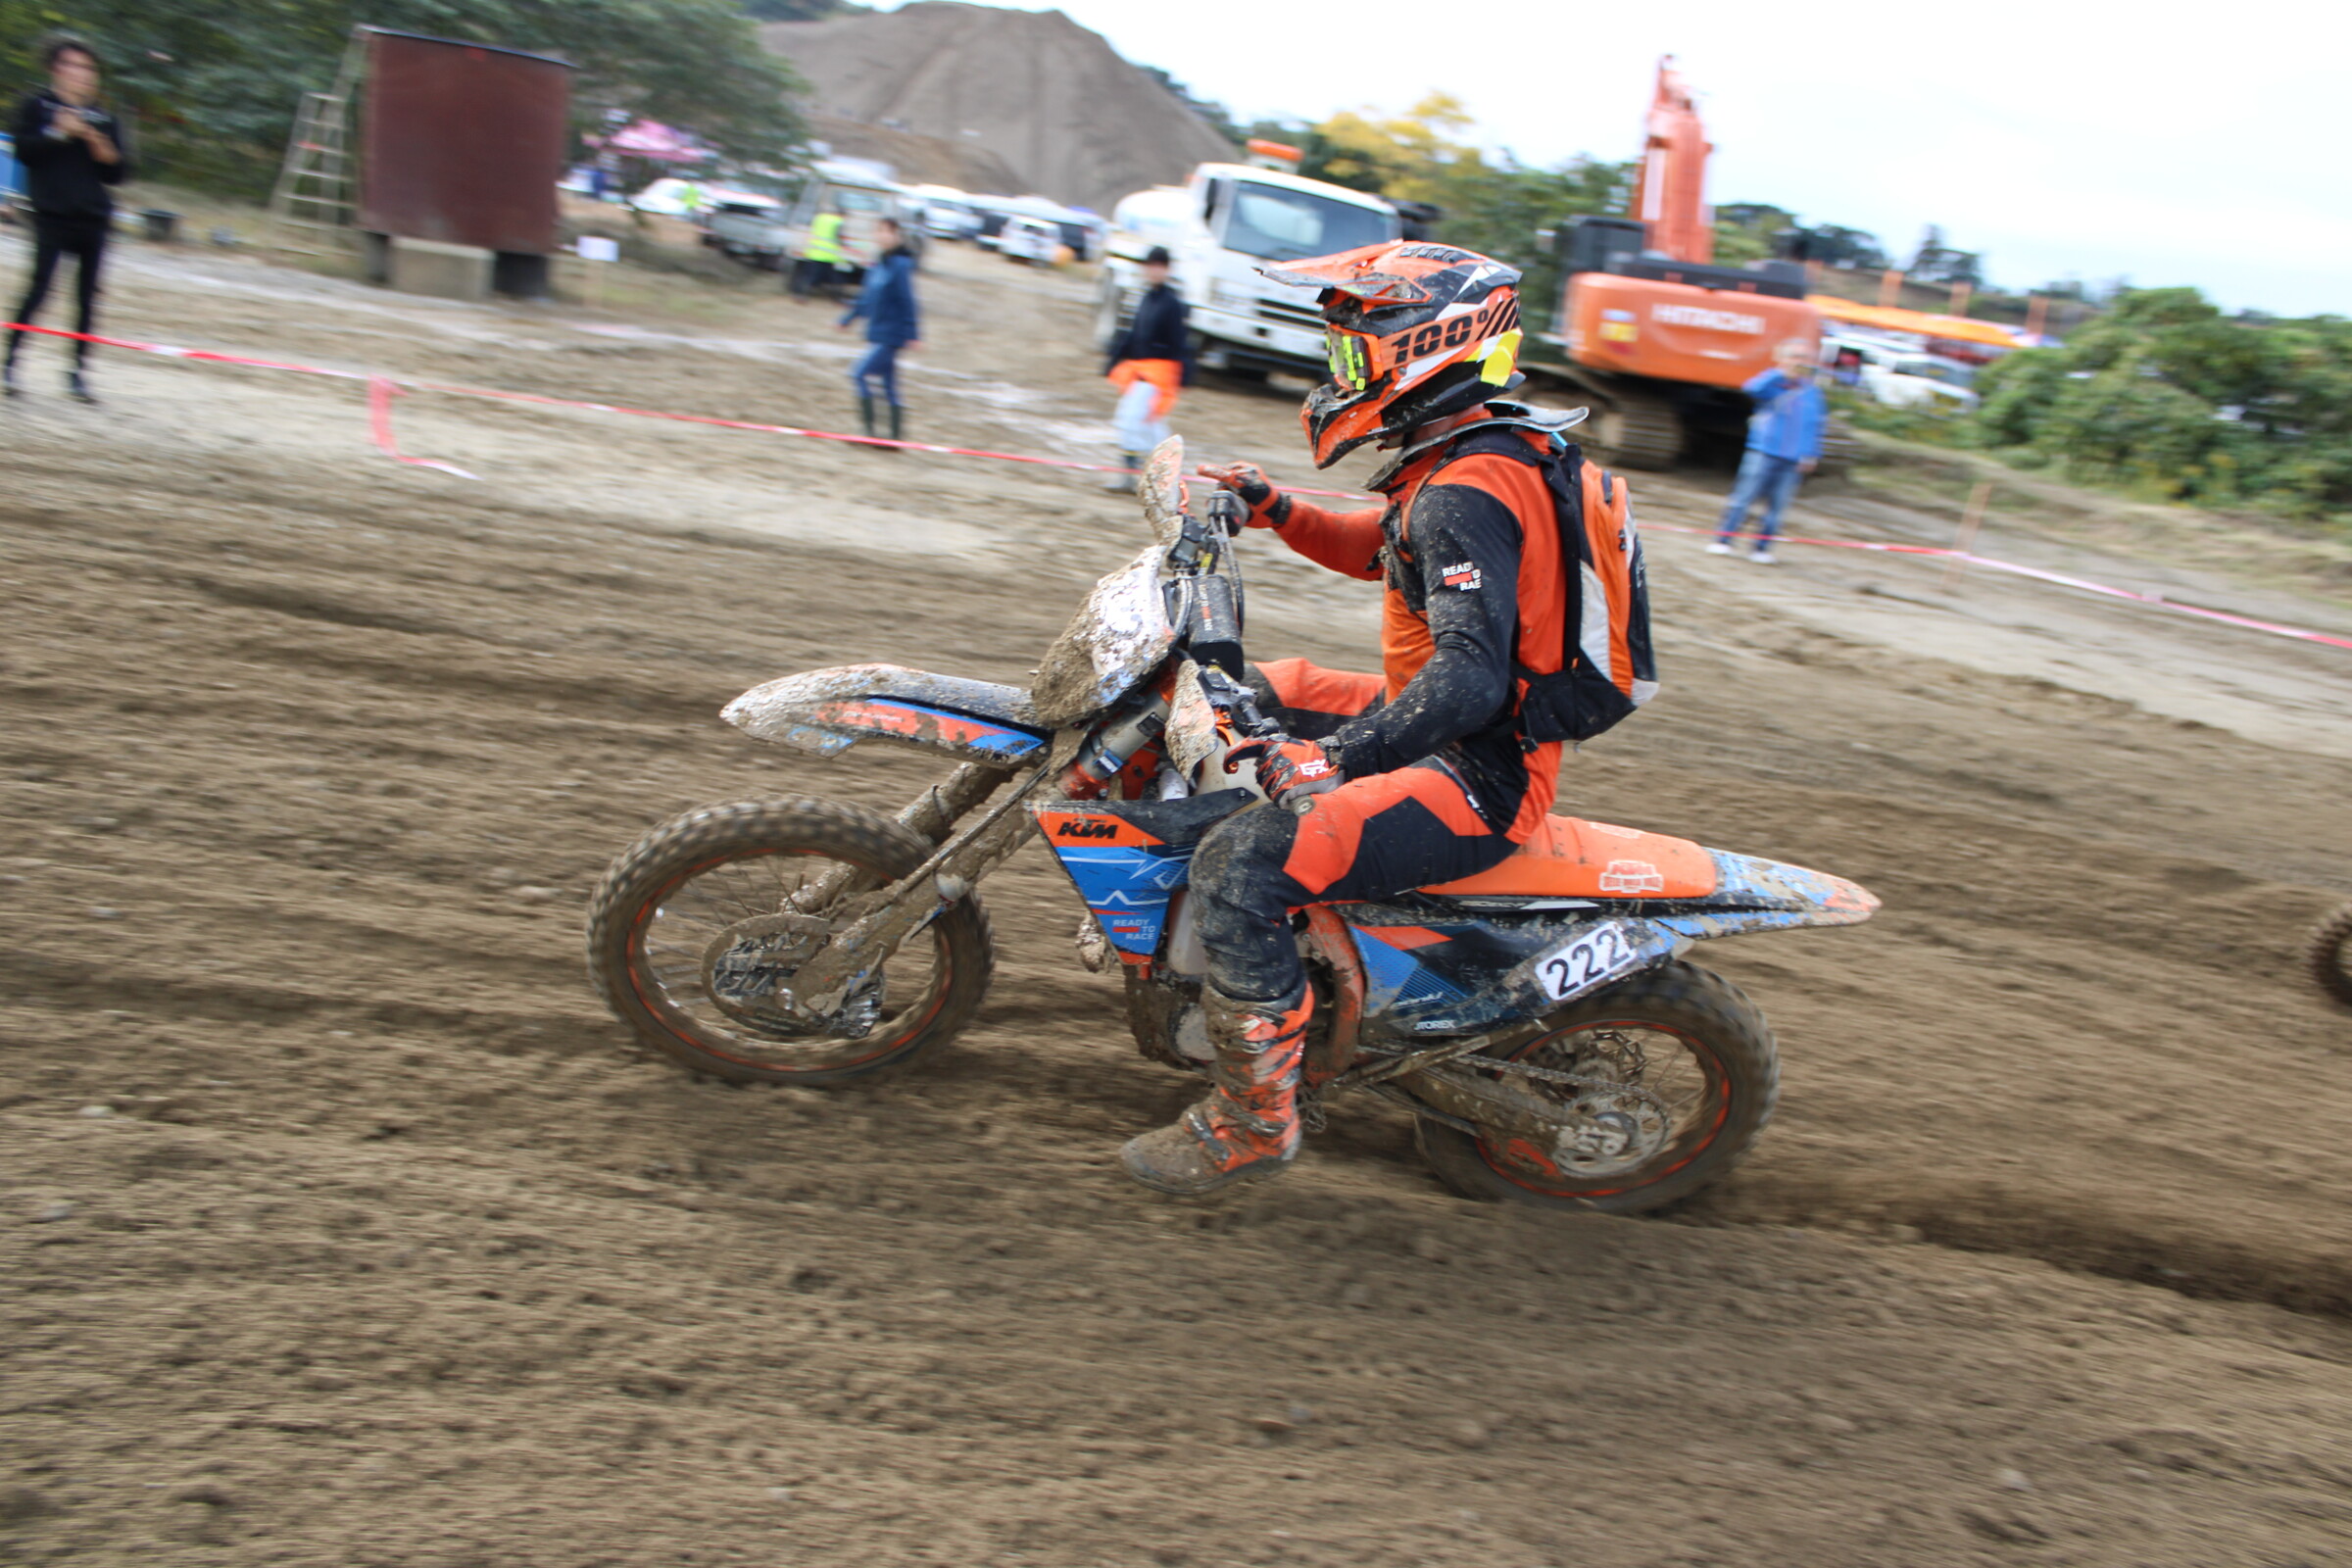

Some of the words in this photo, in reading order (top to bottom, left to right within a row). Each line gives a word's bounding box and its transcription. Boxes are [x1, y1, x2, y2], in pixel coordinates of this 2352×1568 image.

[1651, 303, 1766, 334] HITACHI
[1057, 817, 1119, 839] KTM
[1112, 918, 1151, 927] READY
[1546, 928, 1631, 997] 222
